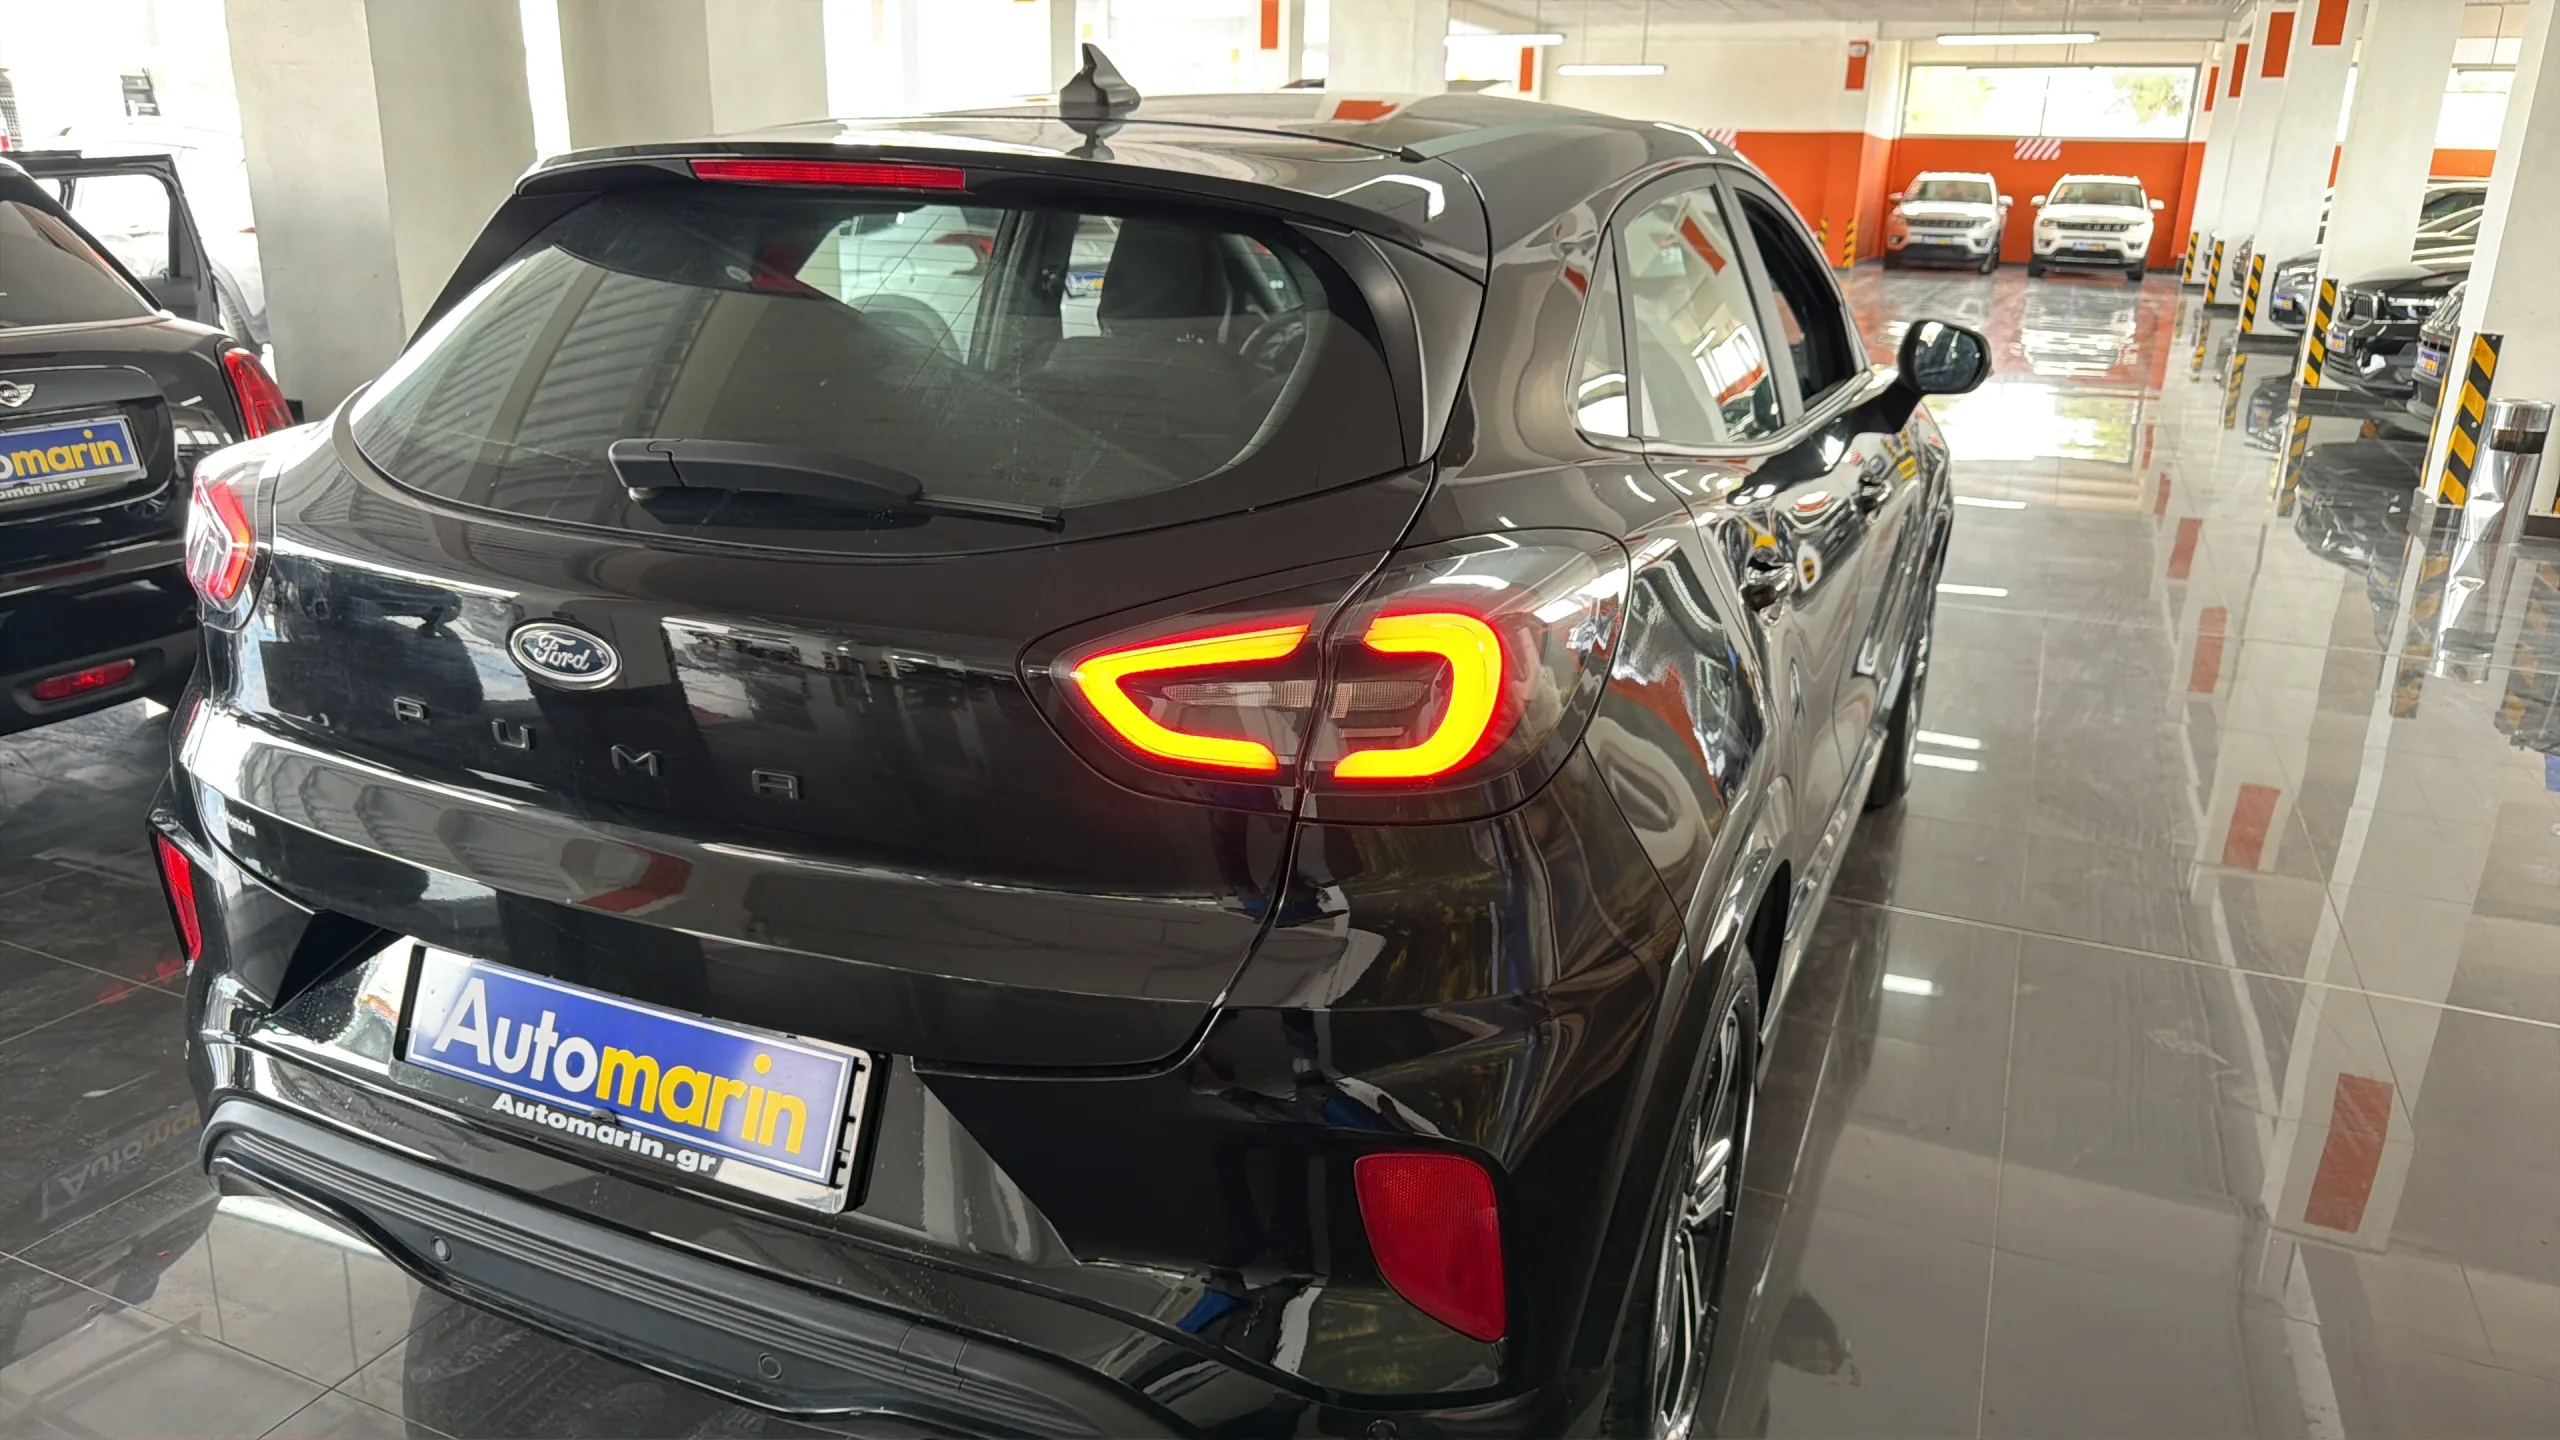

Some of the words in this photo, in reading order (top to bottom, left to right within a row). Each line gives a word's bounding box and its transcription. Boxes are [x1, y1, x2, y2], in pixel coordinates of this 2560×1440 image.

[523, 633, 591, 672] Ford
[394, 696, 801, 800] PUMA
[433, 977, 809, 1155] Automarin
[492, 1092, 717, 1174] Automarin.gr
